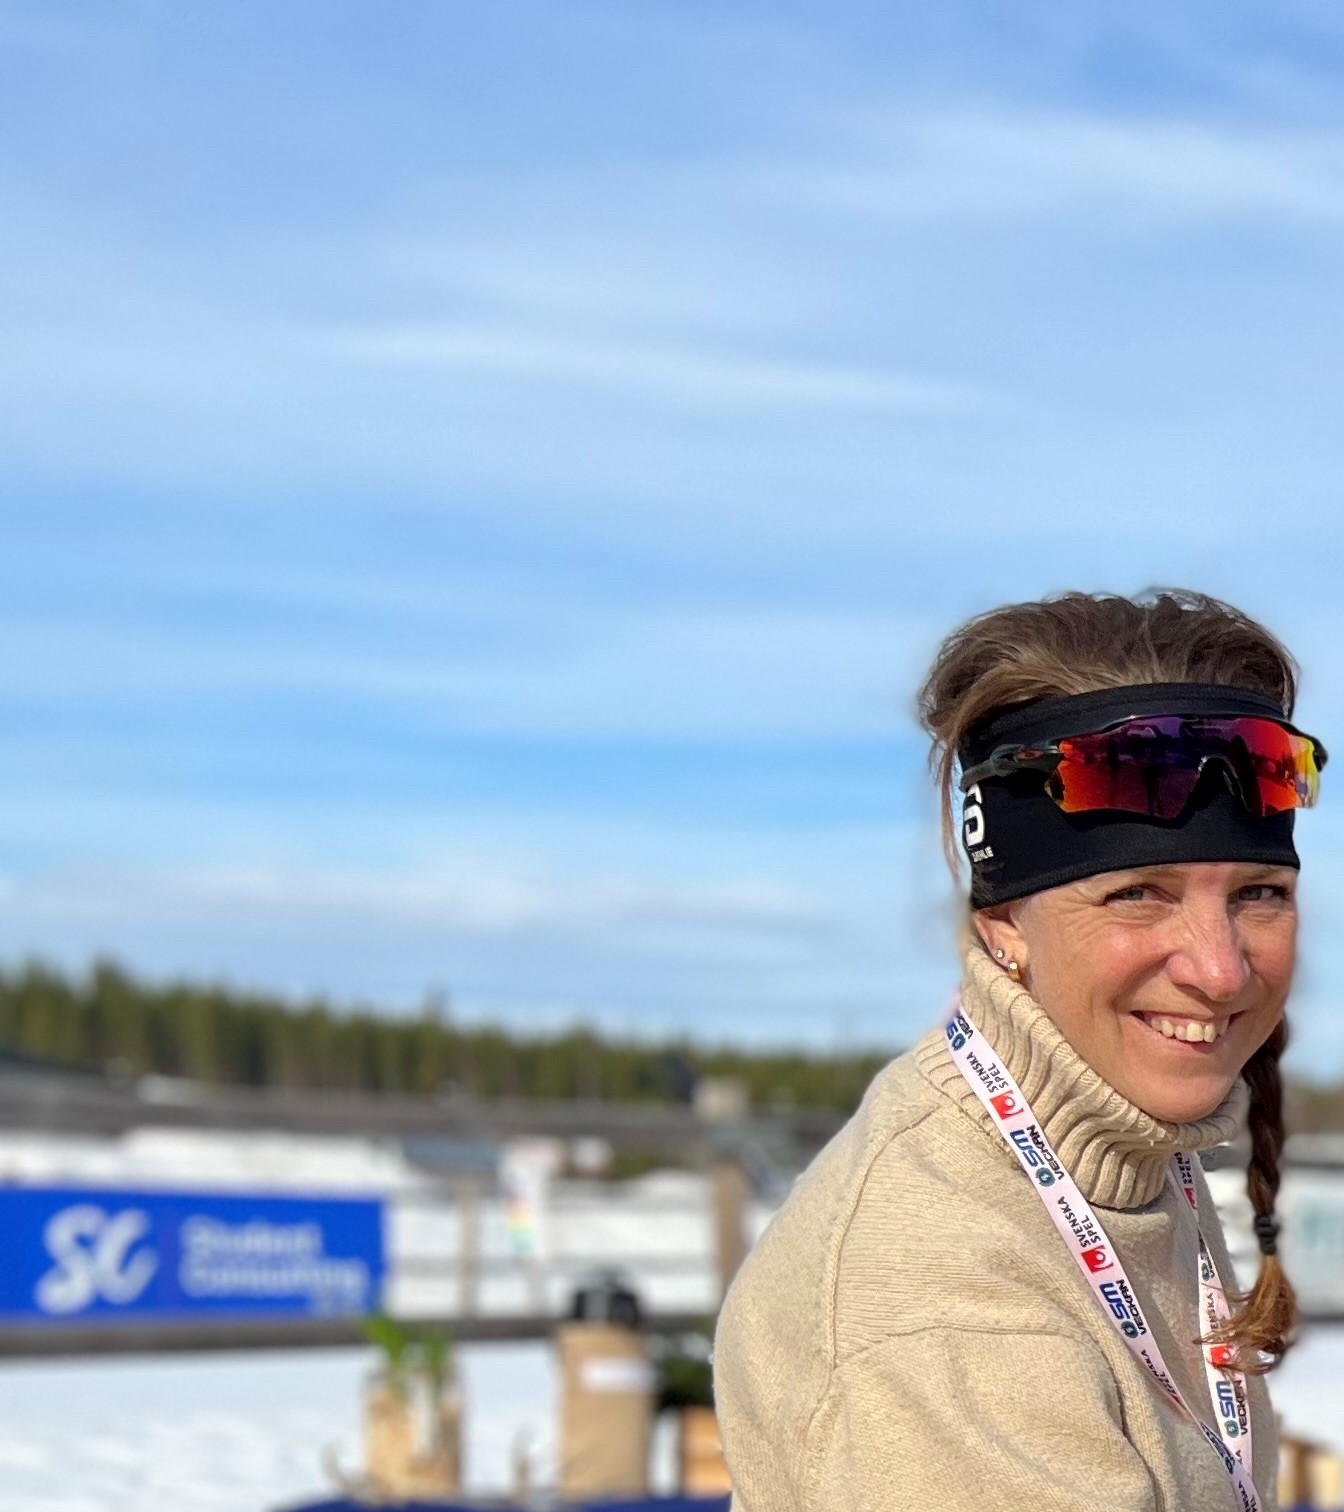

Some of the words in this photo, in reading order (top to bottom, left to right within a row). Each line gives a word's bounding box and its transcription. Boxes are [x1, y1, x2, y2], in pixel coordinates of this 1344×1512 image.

[966, 1051, 999, 1094] SVENSKA
[991, 1062, 1009, 1089] SPEL
[1009, 1128, 1045, 1167] SM
[1026, 1124, 1065, 1181] VECKAN
[1057, 1196, 1091, 1248] SVENSKA
[1080, 1214, 1102, 1244] SPEL
[1099, 1282, 1132, 1320] SM
[1116, 1278, 1147, 1335] VECKAN
[1216, 1380, 1236, 1418] SM
